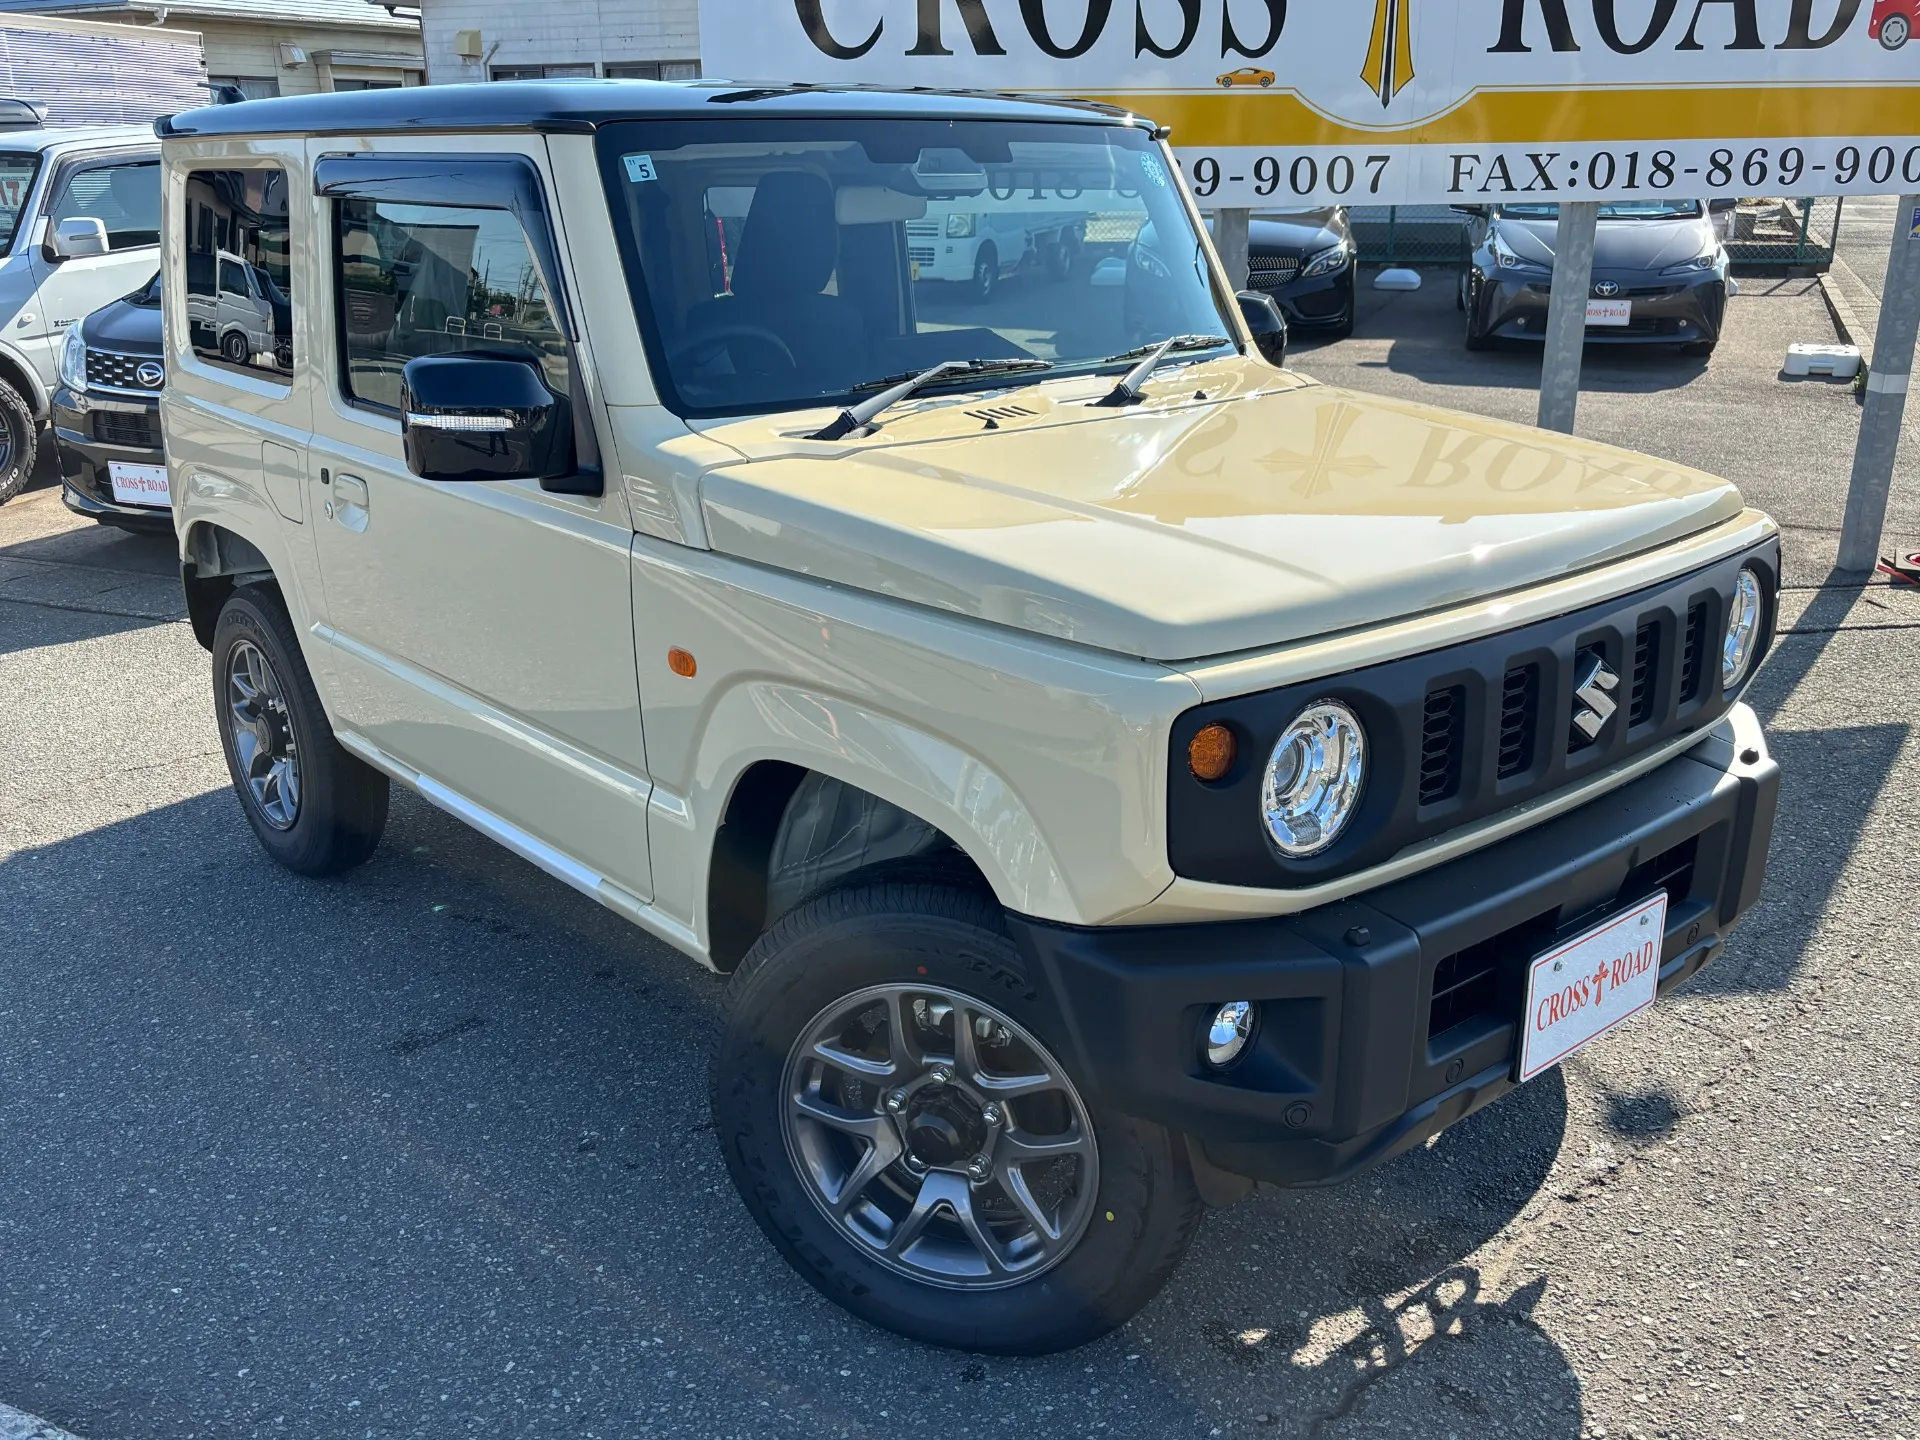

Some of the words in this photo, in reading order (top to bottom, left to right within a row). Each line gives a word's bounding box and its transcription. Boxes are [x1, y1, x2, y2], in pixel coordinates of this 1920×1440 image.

[639, 164, 650, 178] 5
[1610, 309, 1627, 317] ROAD
[116, 476, 138, 489] CROSS
[147, 480, 168, 492] ROAD
[1537, 976, 1590, 1031] CROSS
[1609, 941, 1653, 990] ROAD
